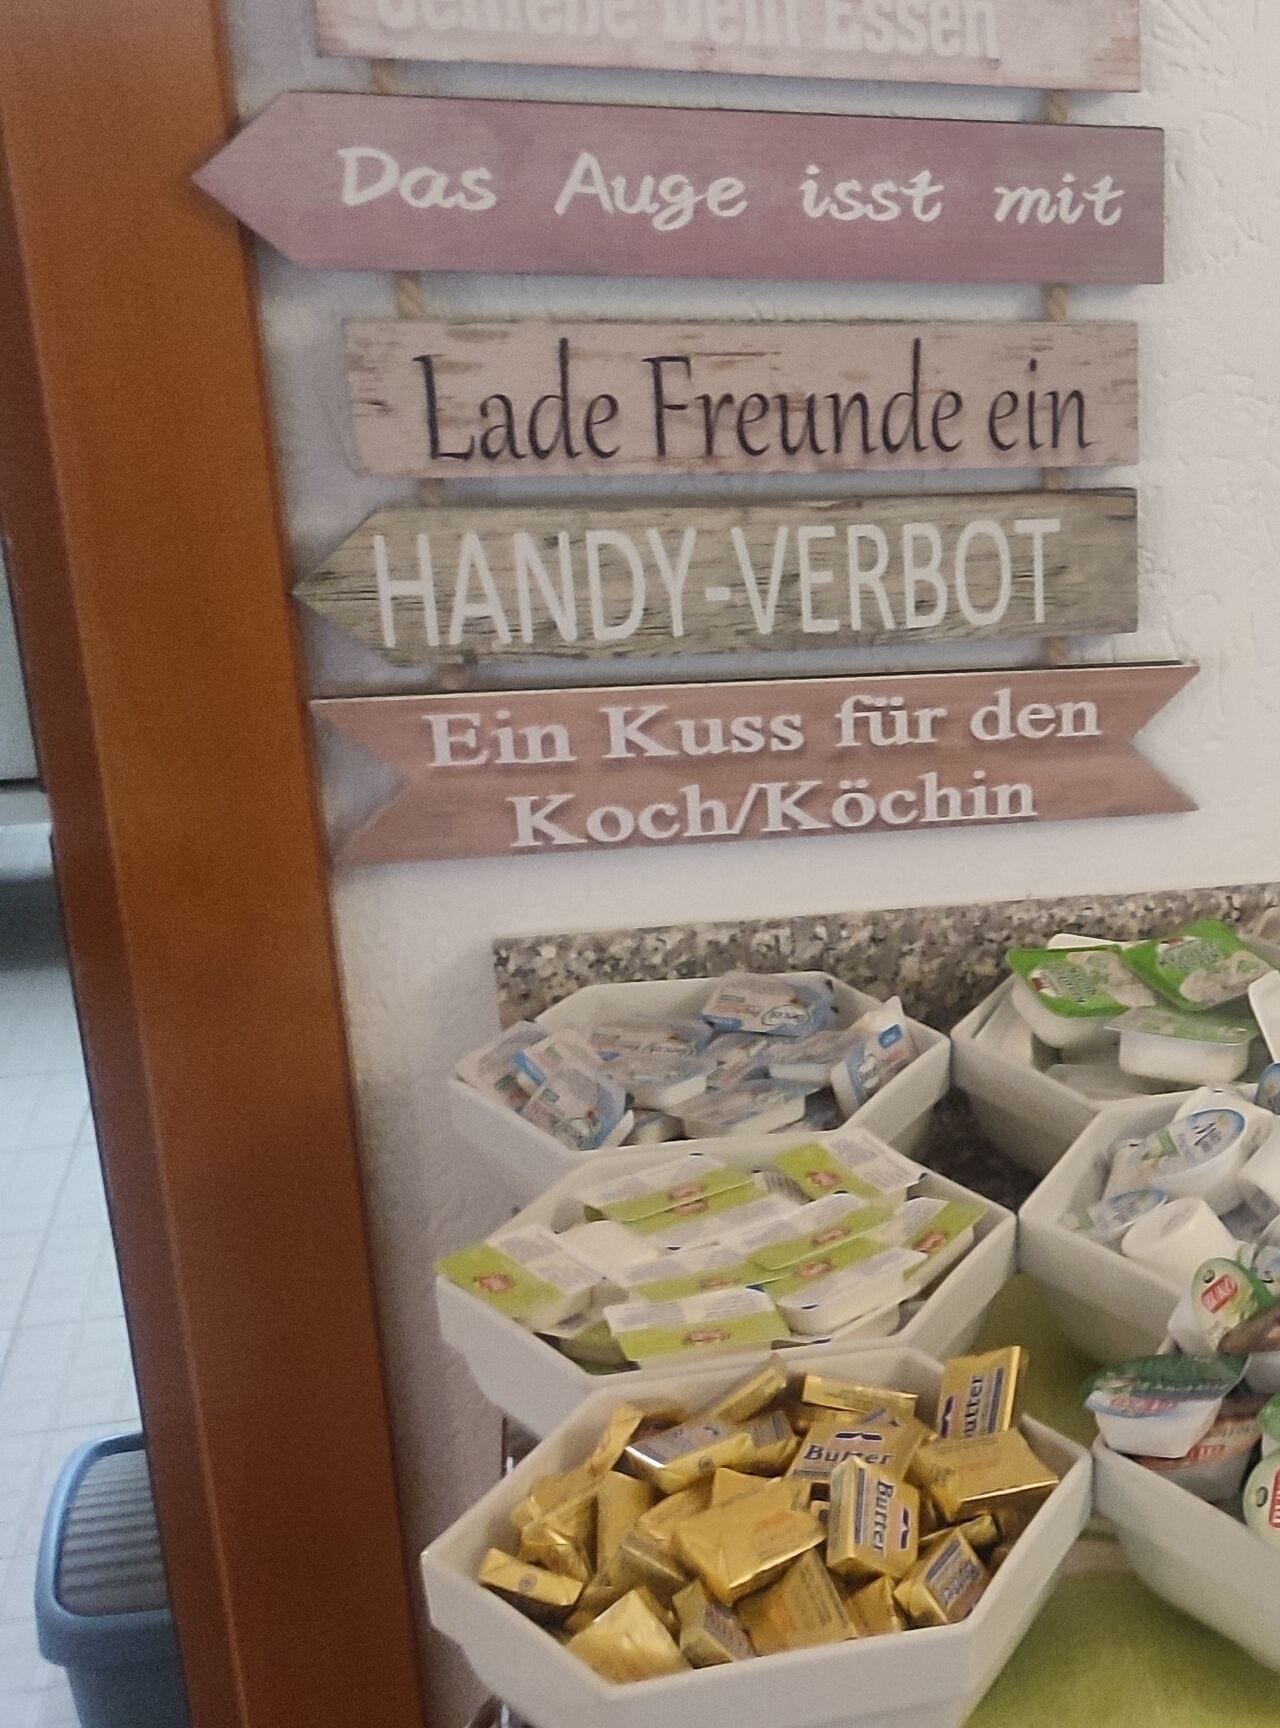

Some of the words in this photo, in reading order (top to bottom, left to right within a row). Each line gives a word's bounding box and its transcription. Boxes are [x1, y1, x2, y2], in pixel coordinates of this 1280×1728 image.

[824, 0, 1000, 59] Essen
[337, 146, 498, 212] Das
[554, 152, 749, 230] Auge
[800, 162, 945, 225] isst
[994, 172, 1123, 228] mit
[414, 338, 619, 462] Lade
[644, 338, 964, 461] Freunde
[988, 361, 1093, 455] ein
[372, 518, 1060, 648] HANDY-VERBOT
[422, 711, 575, 768] Ein
[599, 703, 807, 761] Kuss
[836, 693, 947, 749] für
[970, 690, 1102, 742] den
[509, 769, 1038, 850] Koch/Köchin
[873, 1480, 896, 1551] Butter
